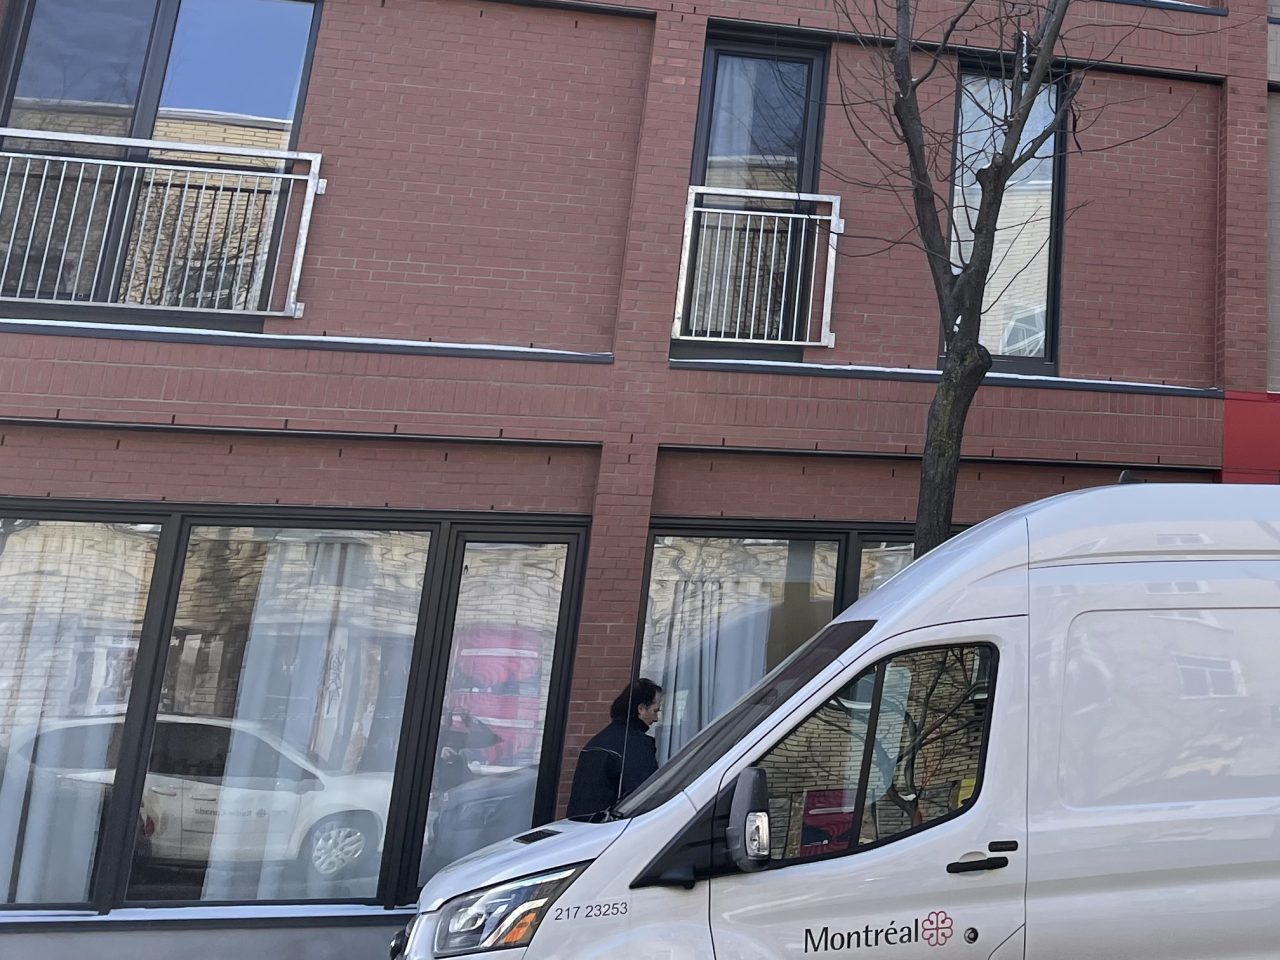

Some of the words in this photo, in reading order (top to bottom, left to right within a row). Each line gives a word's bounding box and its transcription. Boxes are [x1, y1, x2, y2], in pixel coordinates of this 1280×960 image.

[554, 906, 581, 921] 217
[585, 902, 628, 918] 23253
[803, 918, 919, 953] Montréal
